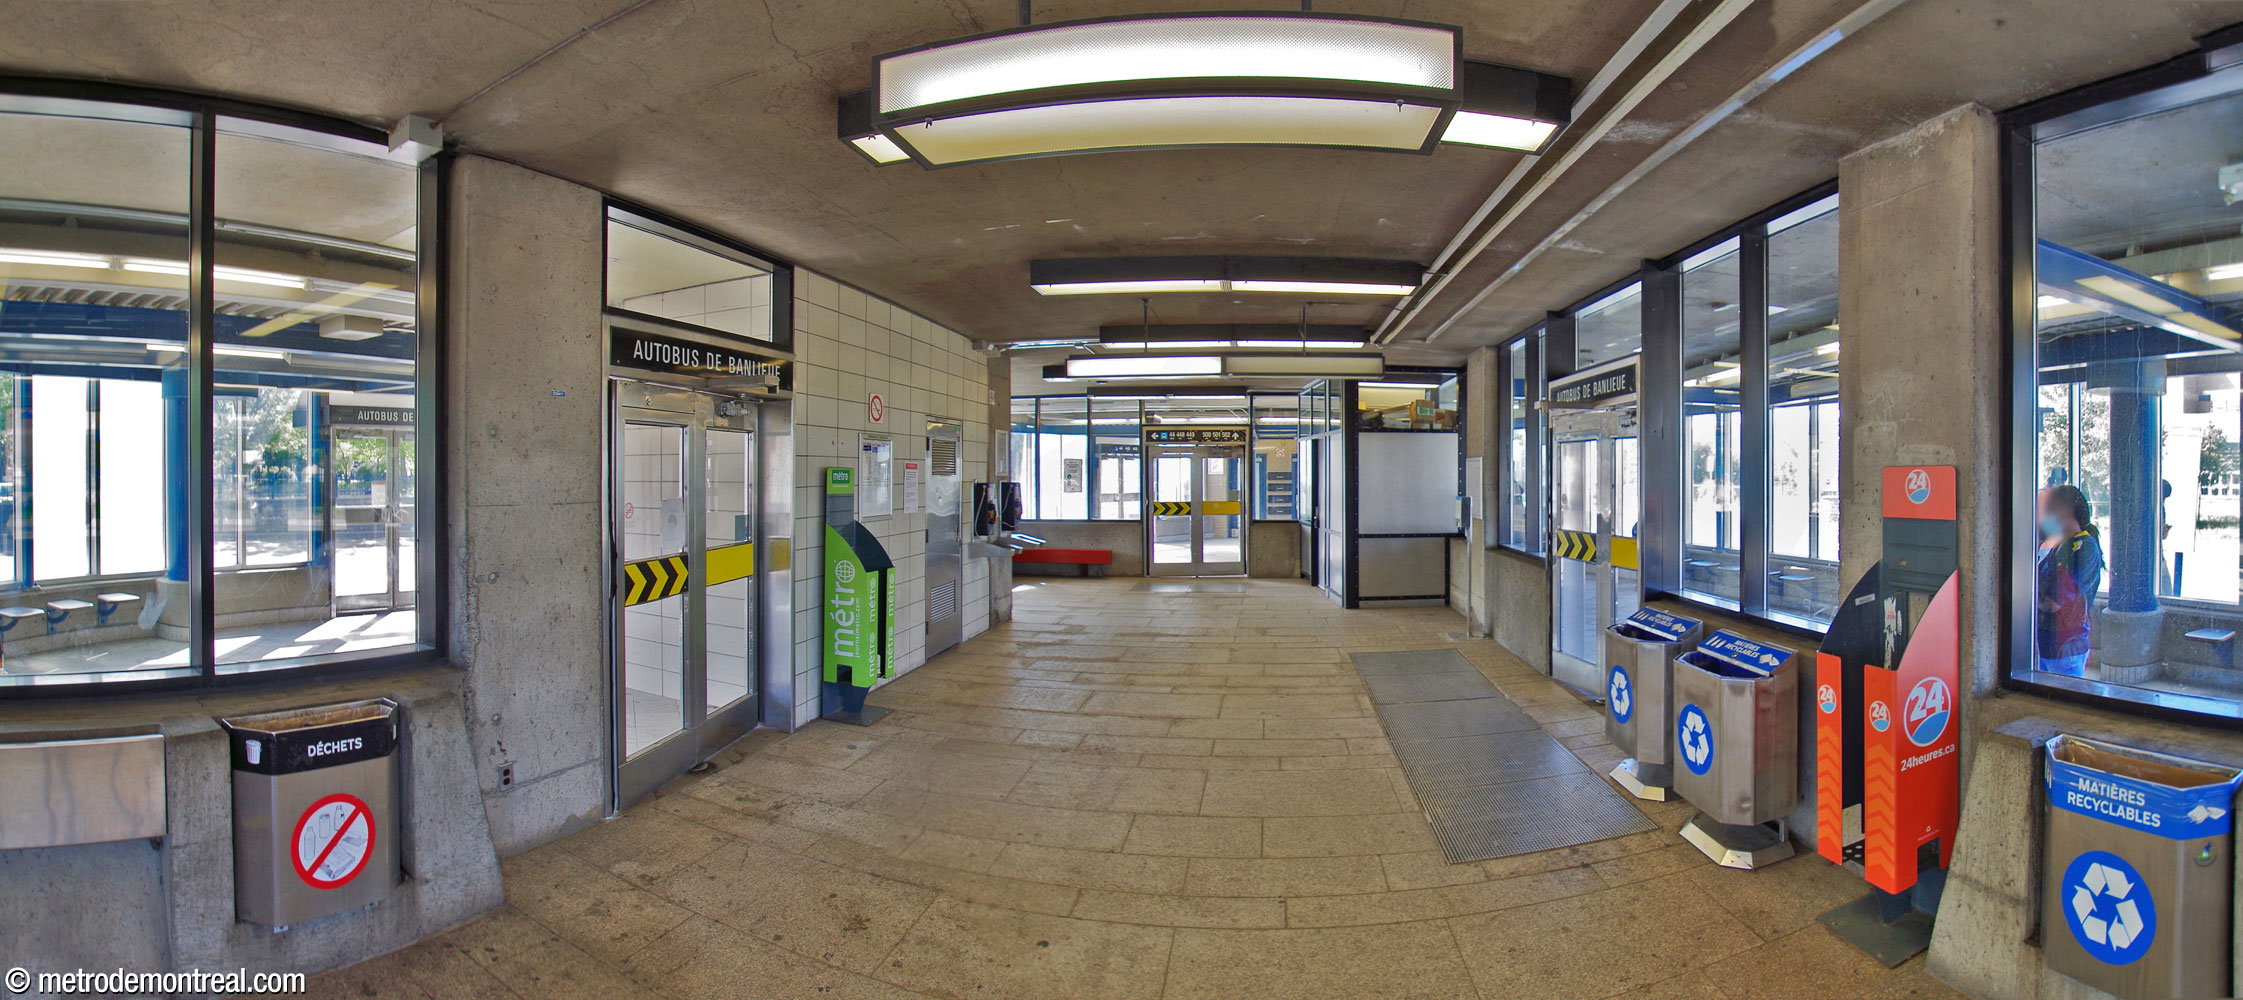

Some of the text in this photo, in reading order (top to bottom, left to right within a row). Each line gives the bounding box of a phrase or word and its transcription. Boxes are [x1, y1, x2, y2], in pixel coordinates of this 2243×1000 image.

[633, 339, 699, 368] AUTOBUS
[706, 352, 722, 371] DE
[1556, 374, 1626, 402] AUTOBUS DE BANLIEUE
[357, 410, 414, 422] AUTOBUS DE
[1908, 470, 1927, 490] 24
[1725, 643, 1760, 659] RECYCLABLES
[1820, 687, 1833, 702] 24
[1910, 680, 1944, 722] 24
[1871, 703, 1887, 720] 24
[307, 737, 363, 758] DÉCHETS
[1901, 744, 1955, 772] 24heures.ca
[2078, 777, 2146, 807] MATIÈRES
[2067, 791, 2161, 828] RECYCLABLES
